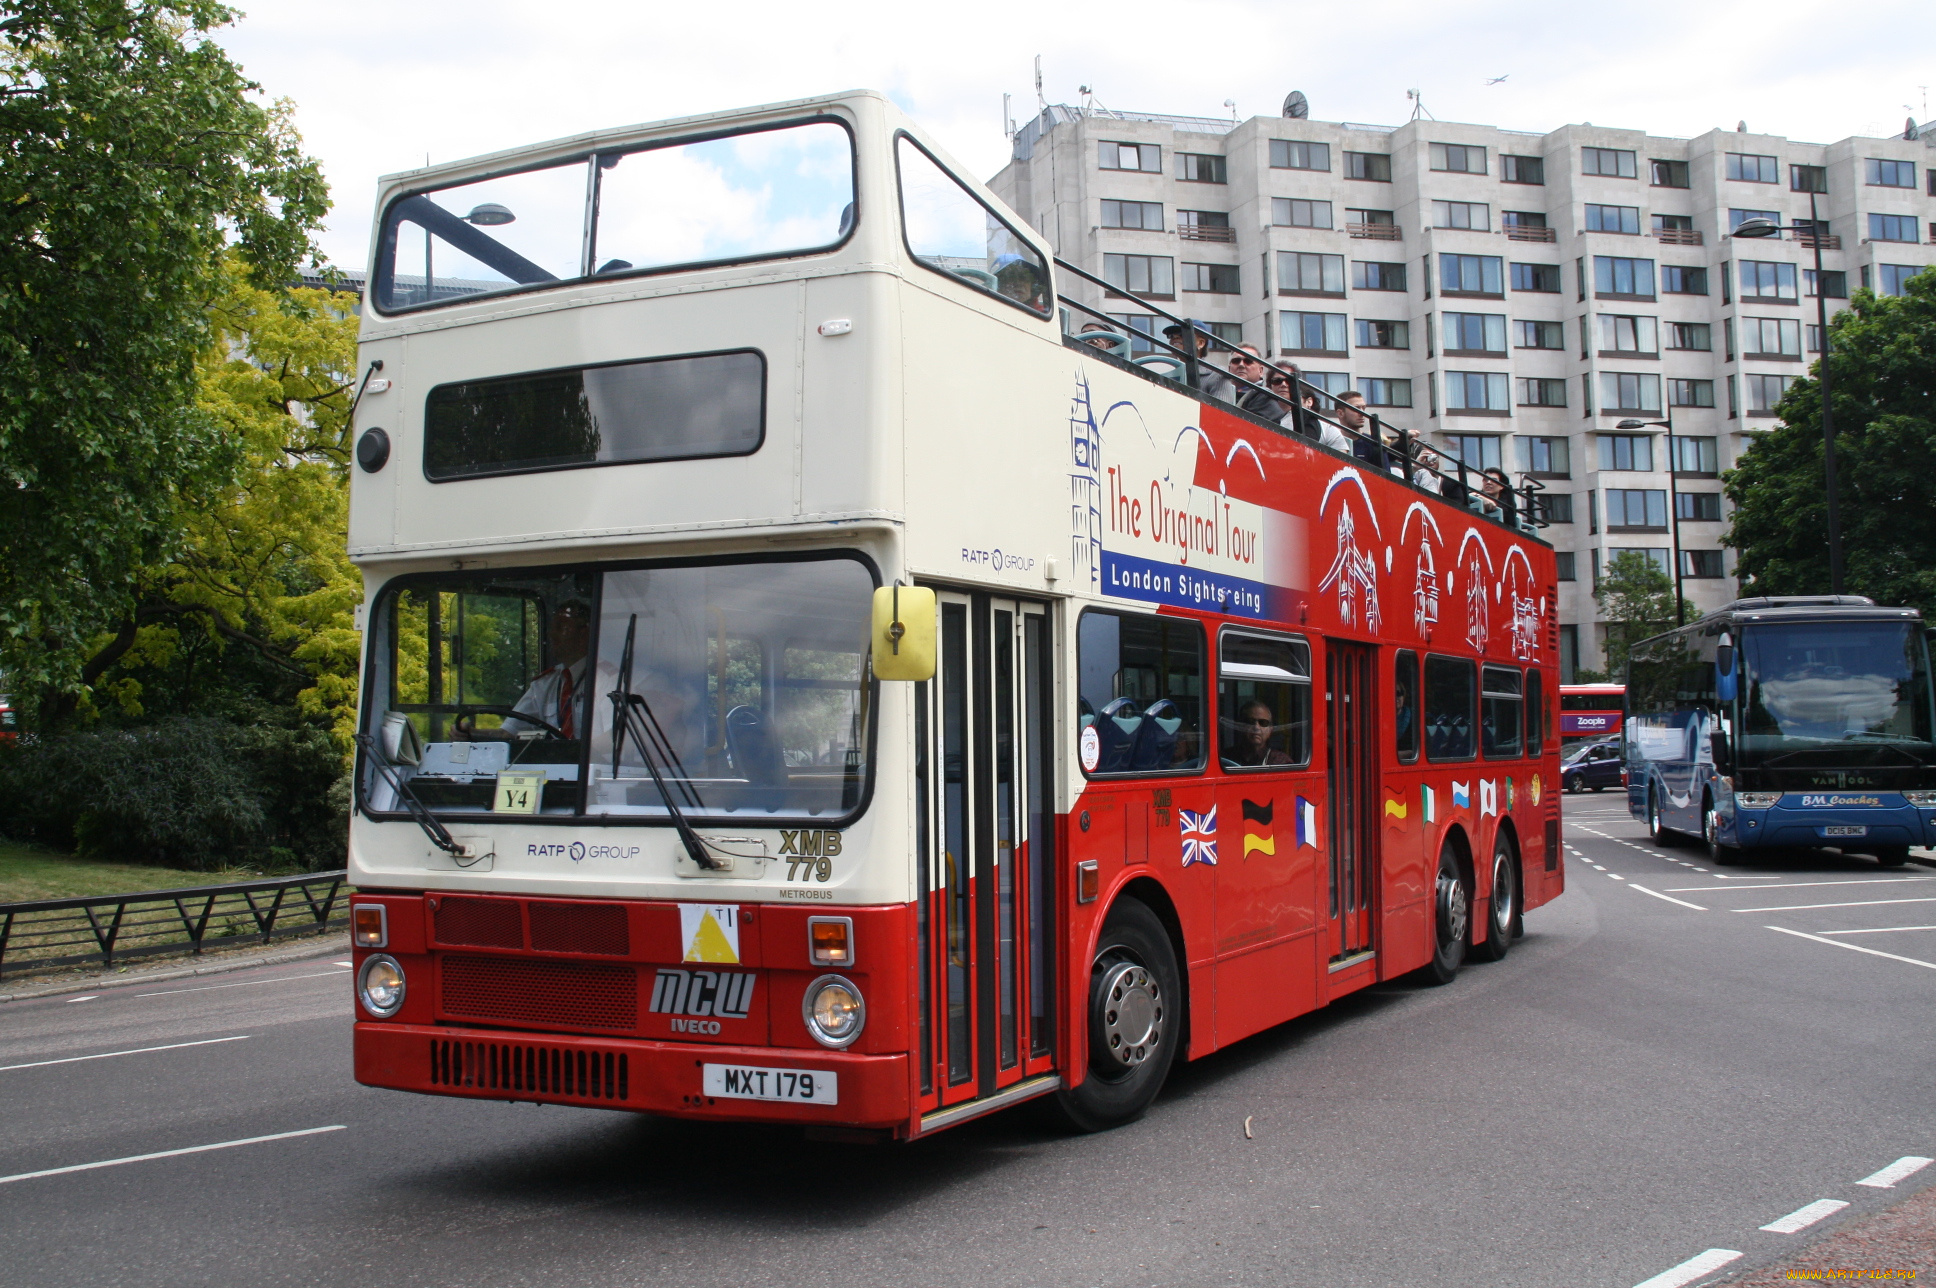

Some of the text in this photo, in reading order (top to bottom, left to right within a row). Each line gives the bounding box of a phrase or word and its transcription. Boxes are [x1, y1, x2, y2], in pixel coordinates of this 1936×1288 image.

[1107, 464, 1256, 565] The Original Tour
[961, 548, 1035, 571] RATP GROUP
[1111, 563, 1171, 593] London
[1577, 717, 1606, 726] Zoopla
[506, 789, 528, 808] Y4
[1801, 795, 1880, 806] BM Coaches
[527, 844, 640, 859] RATP GROUP
[778, 830, 843, 856] XMB
[785, 856, 833, 883] 779
[779, 889, 833, 900] METROBUS
[670, 1018, 722, 1036] IVECO
[725, 1068, 814, 1099] MXT 179
